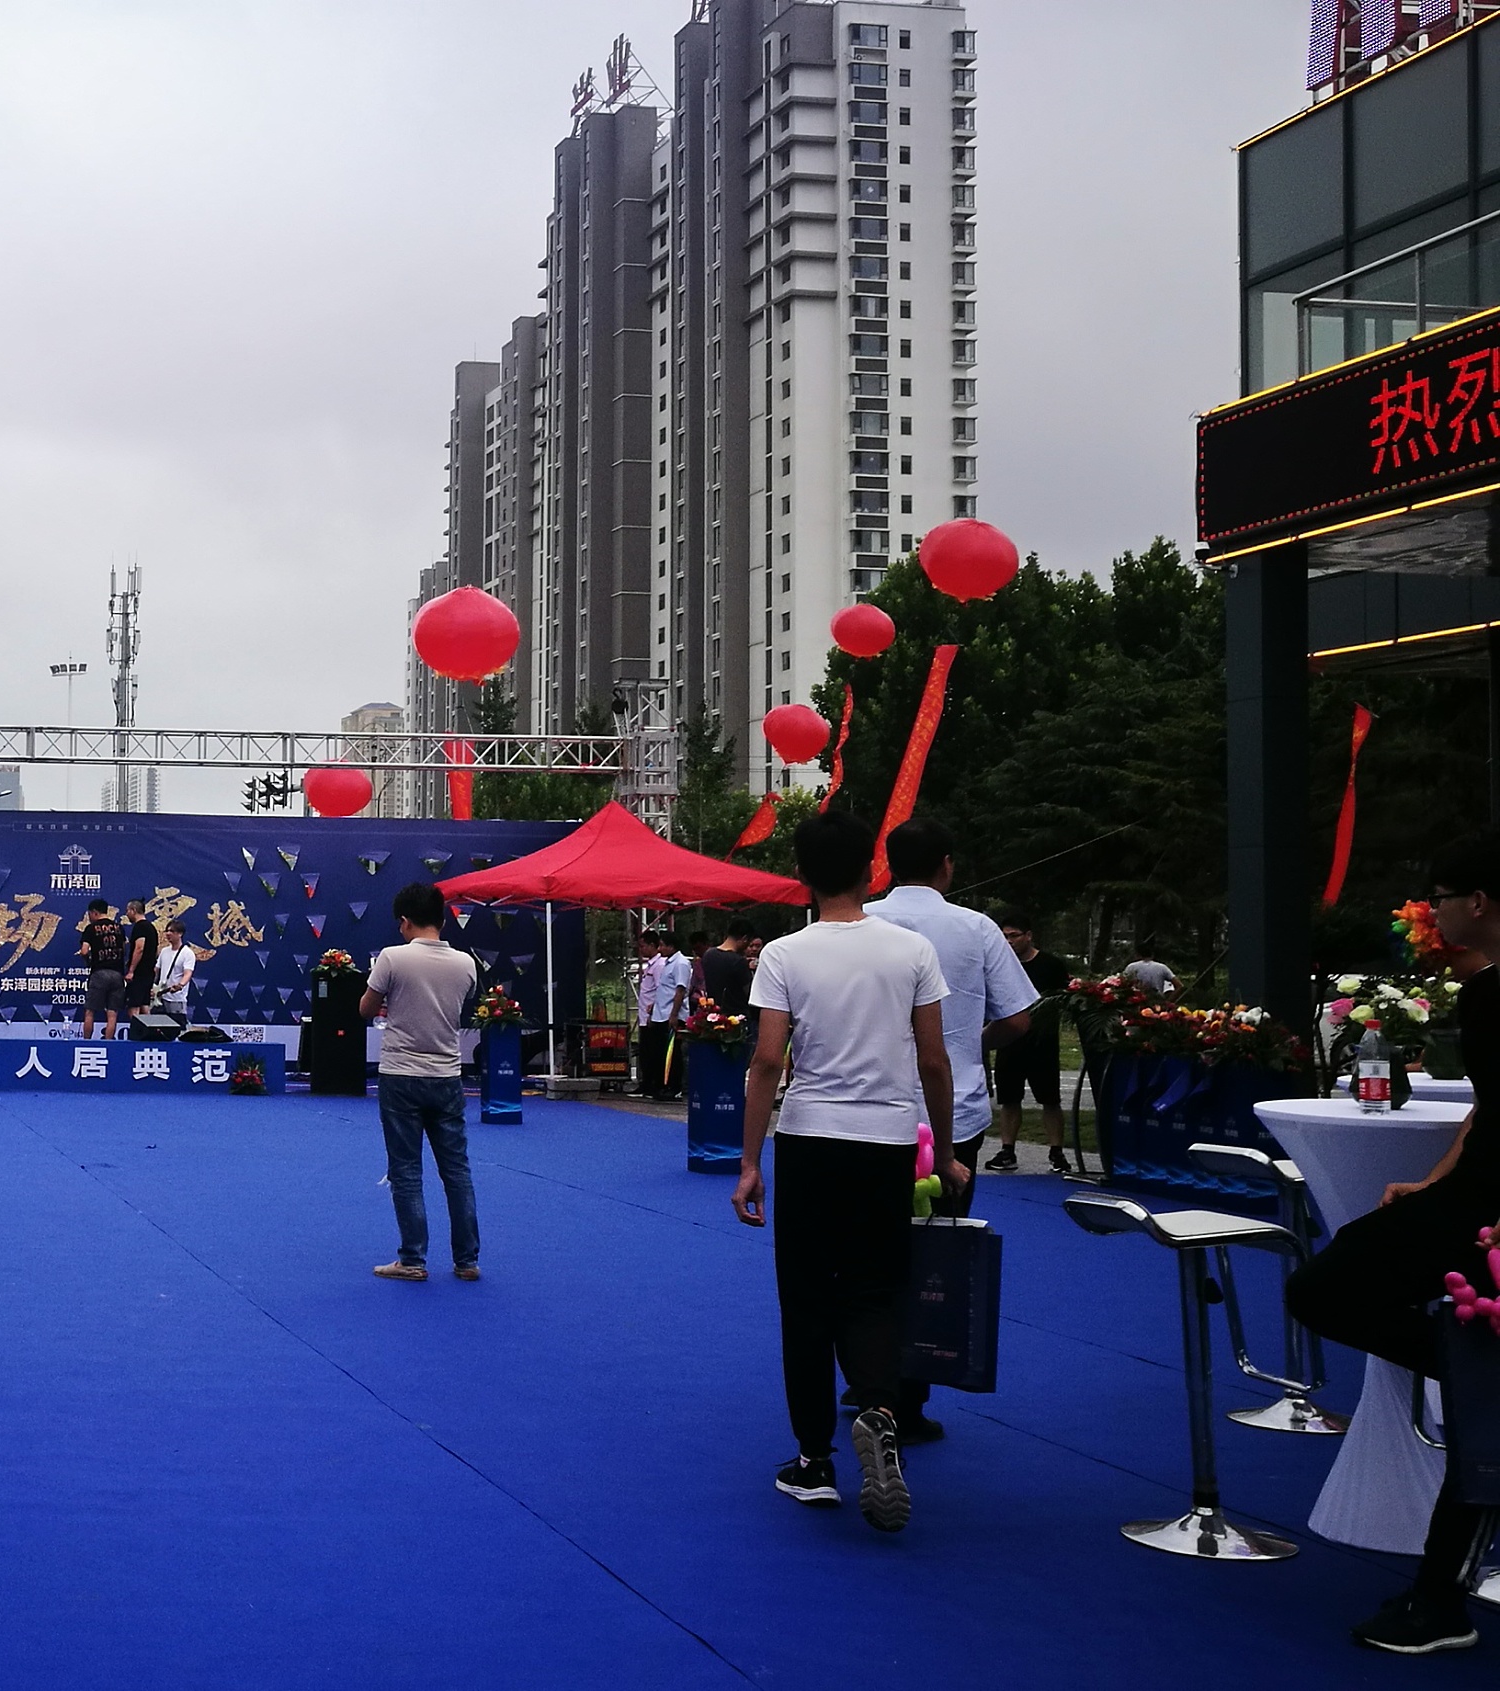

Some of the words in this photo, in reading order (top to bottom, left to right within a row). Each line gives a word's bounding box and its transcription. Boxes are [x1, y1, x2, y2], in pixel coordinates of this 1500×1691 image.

[1369, 347, 1500, 474] 热烈
[50, 874, 101, 889] 东泽园
[15, 1047, 232, 1084] 人居典范
